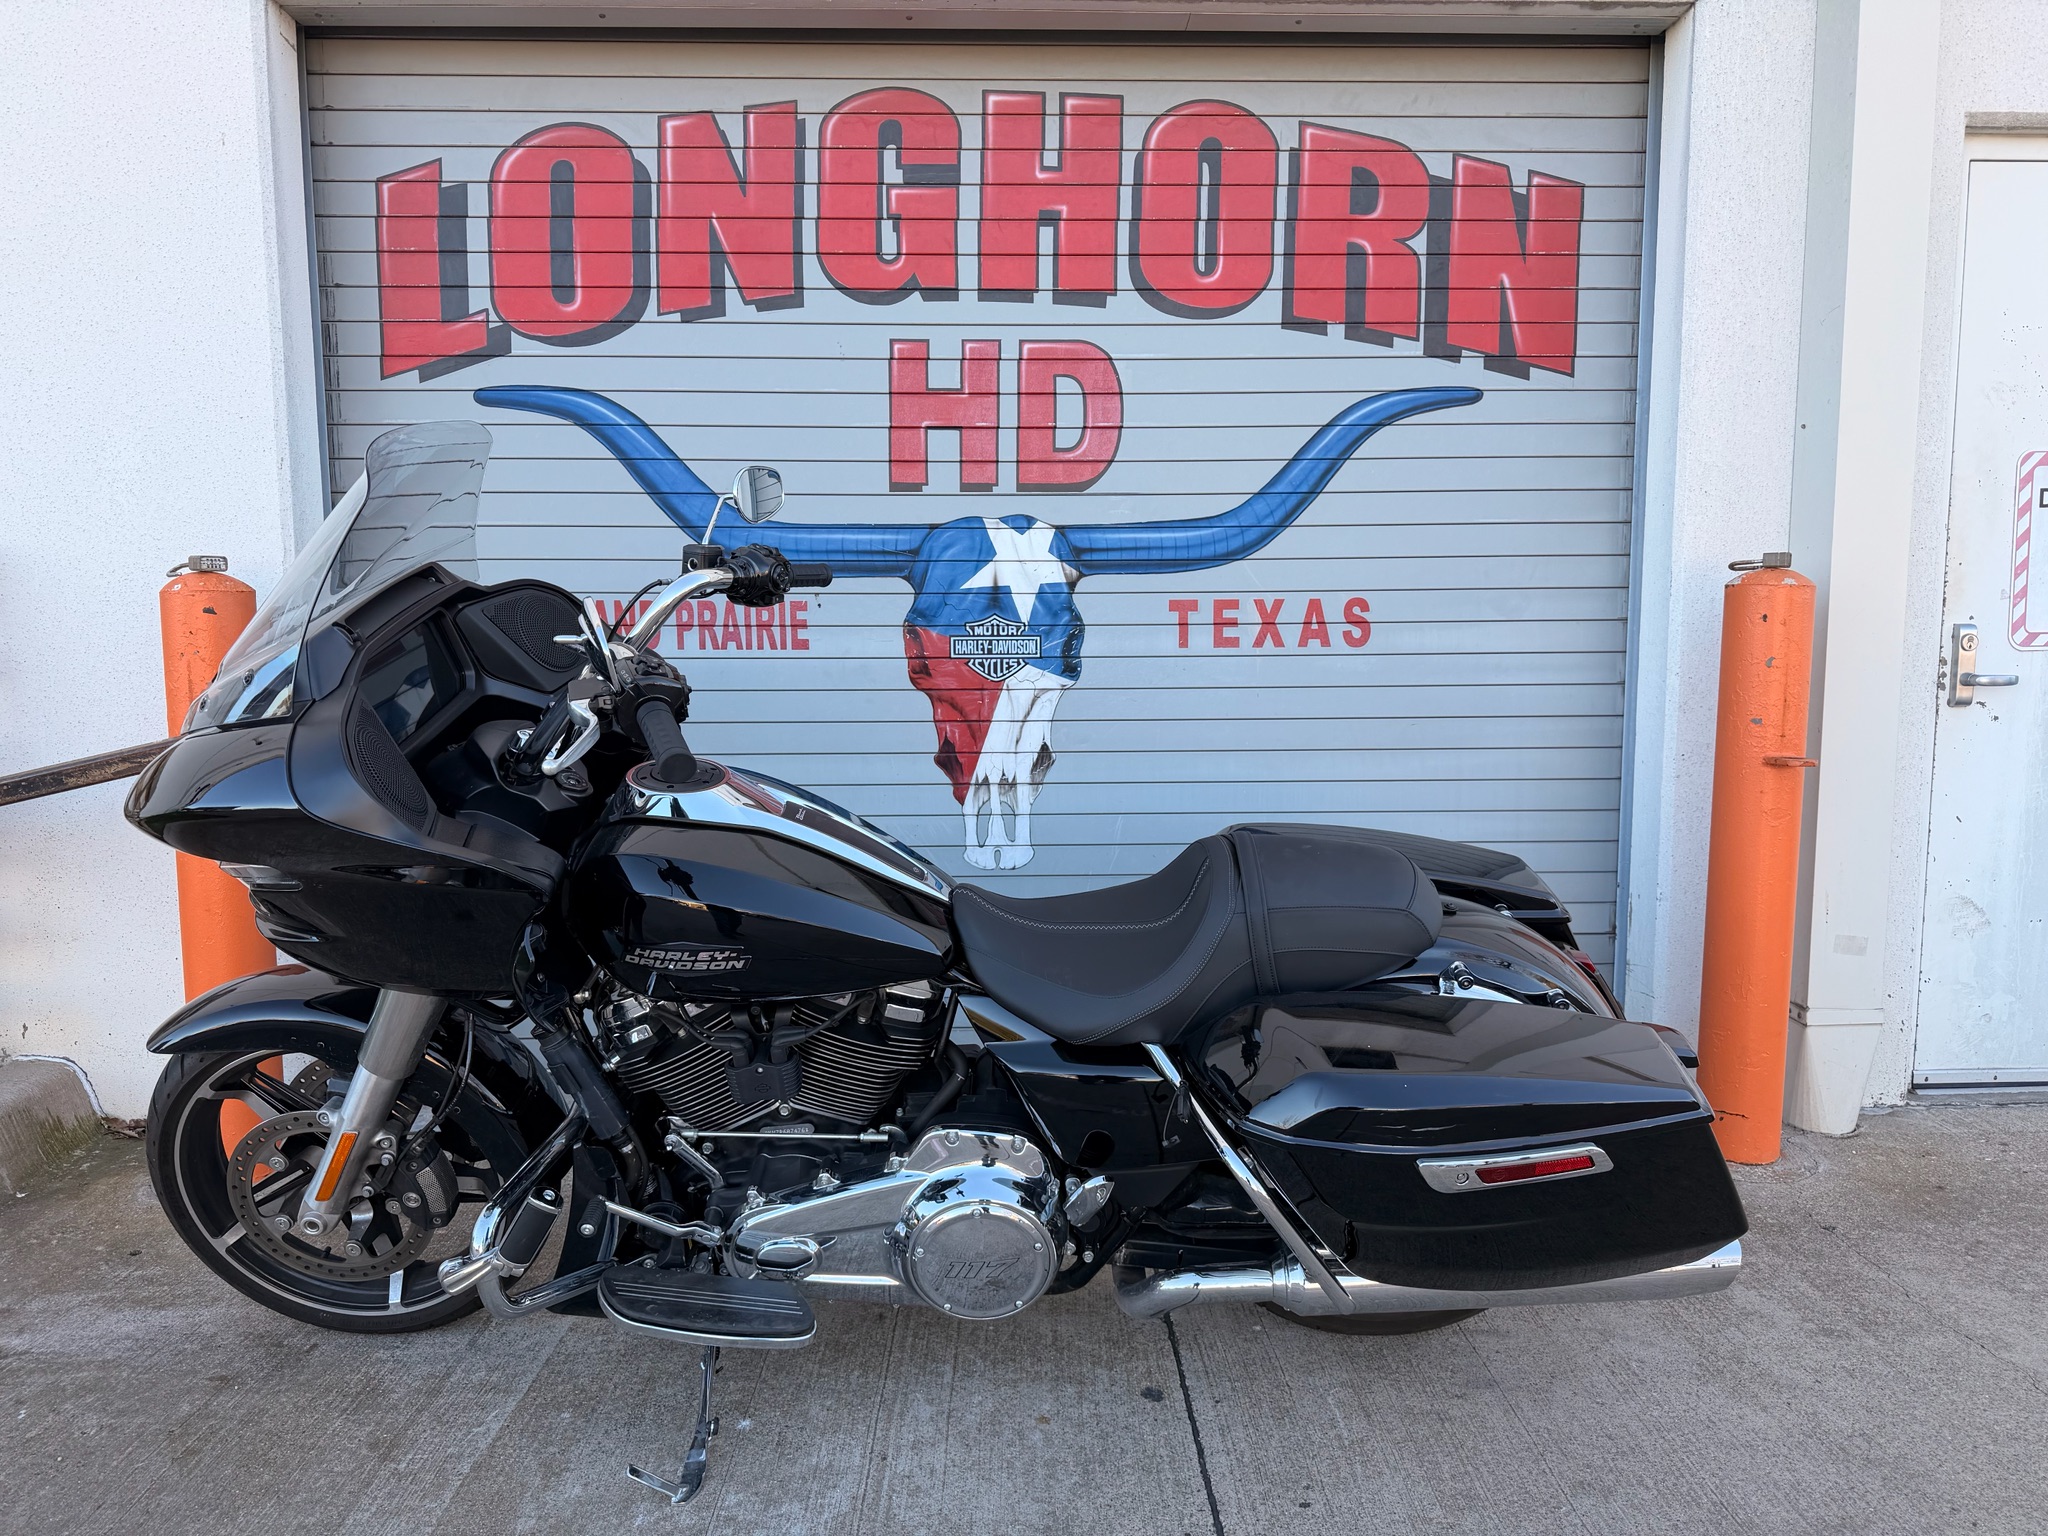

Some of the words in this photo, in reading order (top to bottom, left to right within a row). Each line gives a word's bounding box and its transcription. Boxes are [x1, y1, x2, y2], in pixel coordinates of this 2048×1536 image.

[376, 86, 1585, 382] LONGHORN
[889, 339, 1123, 493] HD
[675, 600, 811, 651] PRAIRIE
[974, 619, 1017, 636] MOTOR
[1168, 597, 1372, 648] TEXAS
[955, 640, 1036, 655] HARLEY-DAVIDSON
[974, 658, 1019, 678] CYCLES
[624, 954, 746, 971] DAVIDSON
[633, 947, 738, 961] HARLEY-
[944, 1257, 1020, 1279] 117
